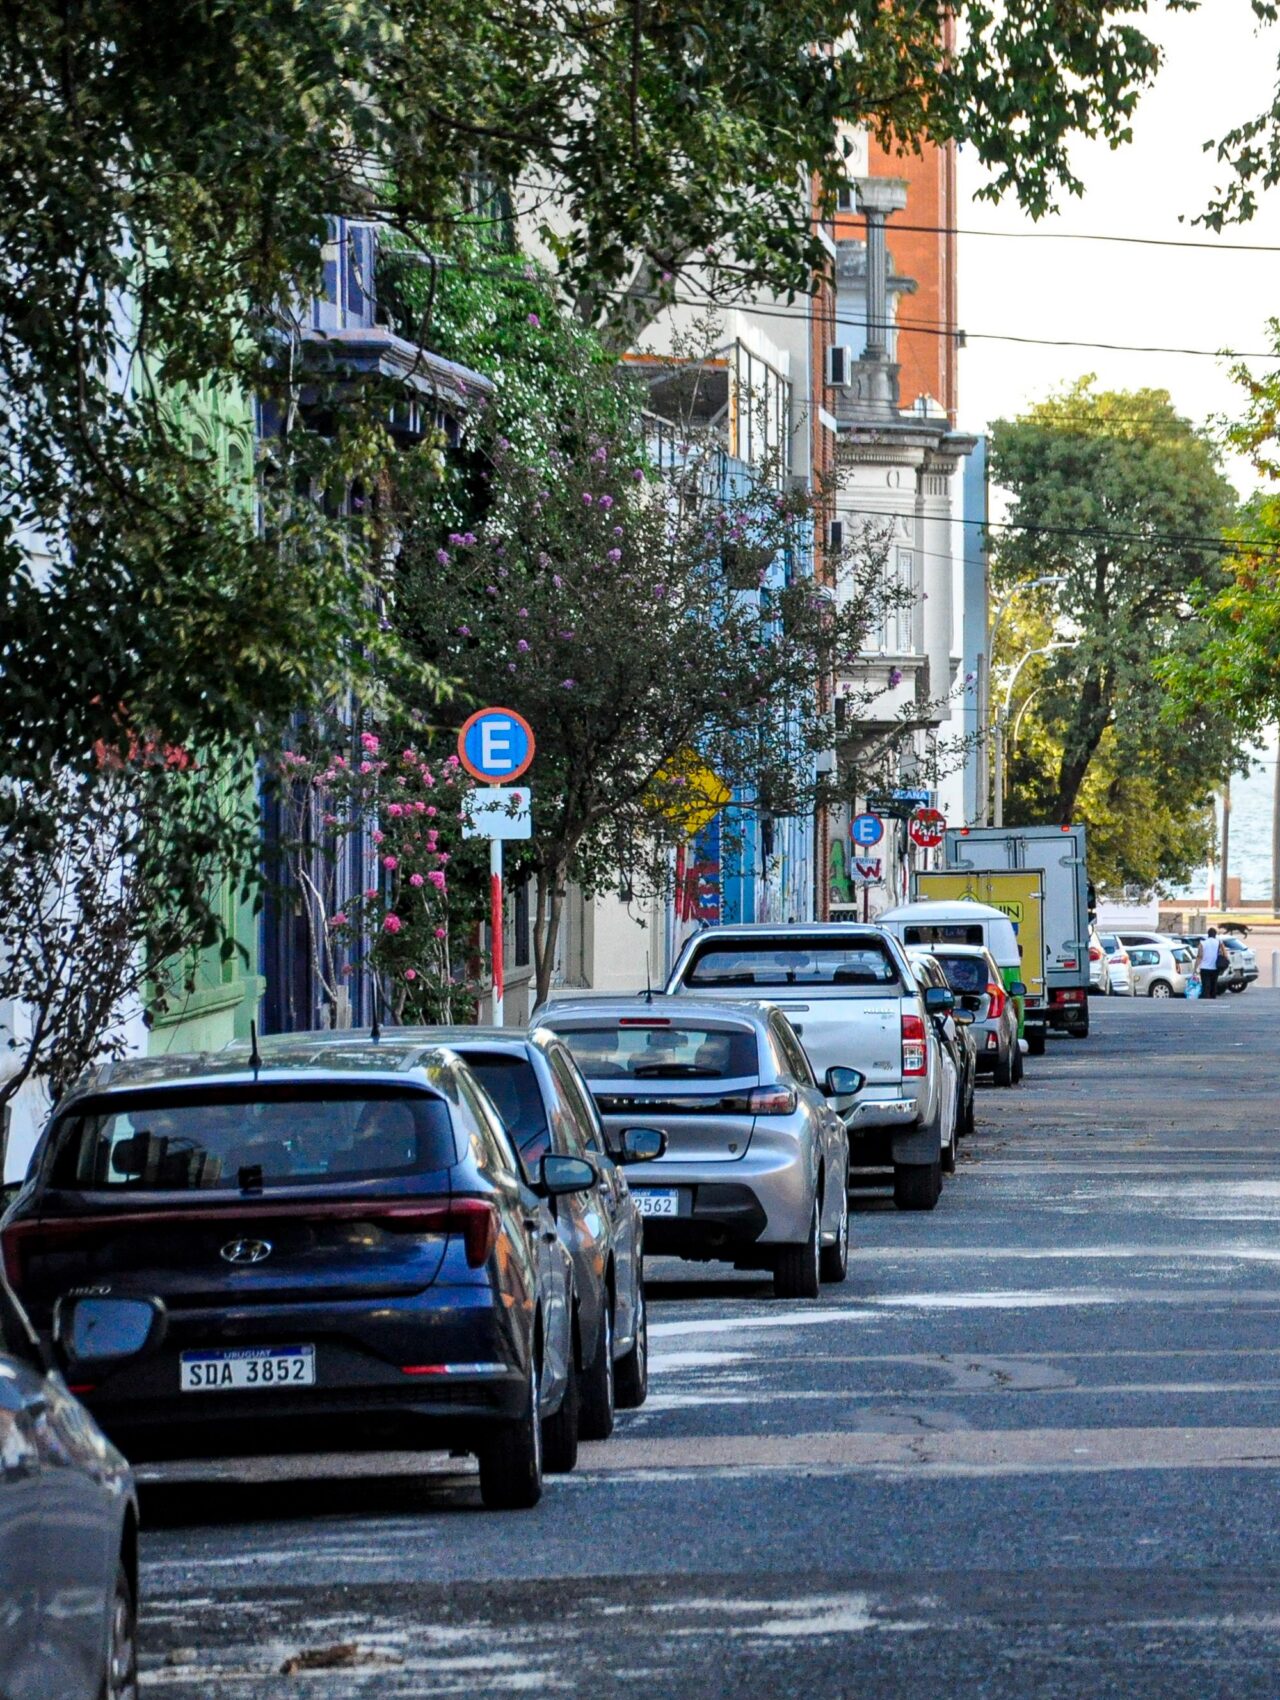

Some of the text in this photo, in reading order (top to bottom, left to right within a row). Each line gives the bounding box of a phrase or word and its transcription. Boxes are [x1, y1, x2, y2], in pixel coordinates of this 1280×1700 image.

[482, 722, 512, 768] E
[860, 818, 874, 841] E
[223, 1349, 273, 1360] URUGUAY
[189, 1359, 305, 1386] SDA 3852
